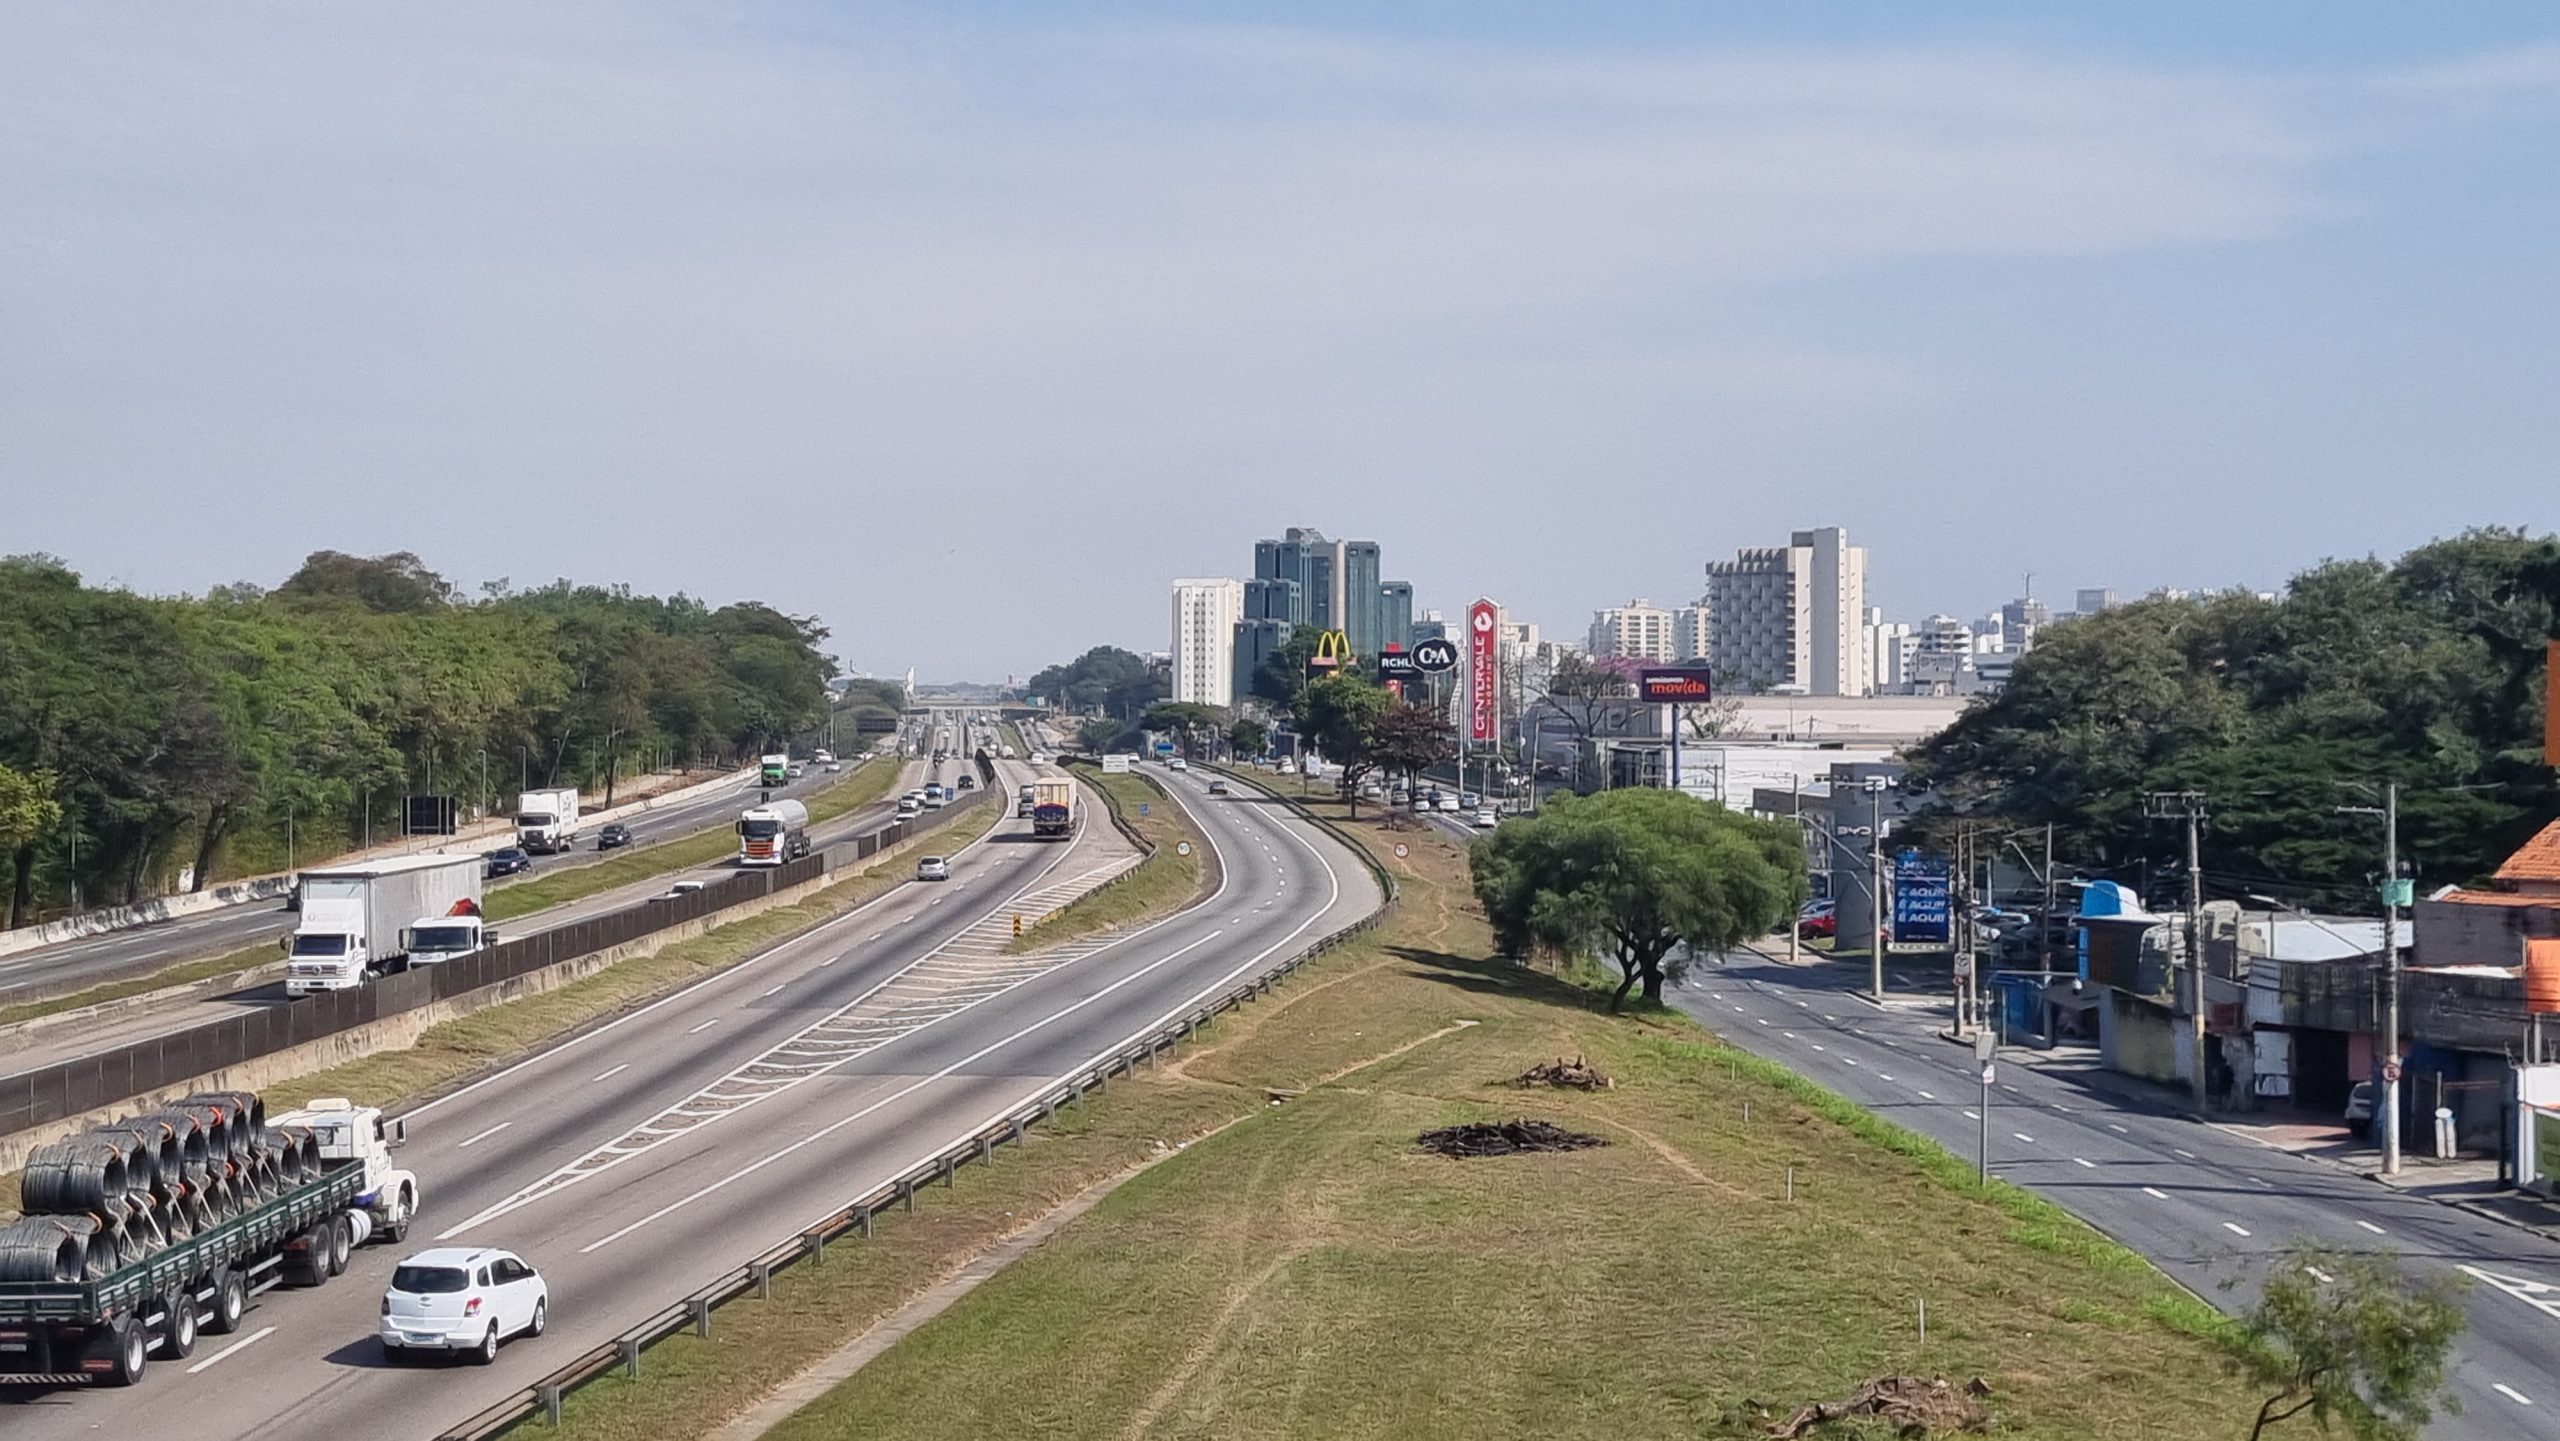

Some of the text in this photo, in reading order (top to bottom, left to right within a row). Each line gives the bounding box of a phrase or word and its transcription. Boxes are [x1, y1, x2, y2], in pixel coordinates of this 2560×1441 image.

[1381, 657, 1412, 668] RCHL
[1419, 647, 1450, 664] C&A
[1475, 636, 1485, 731] CENTERVALE
